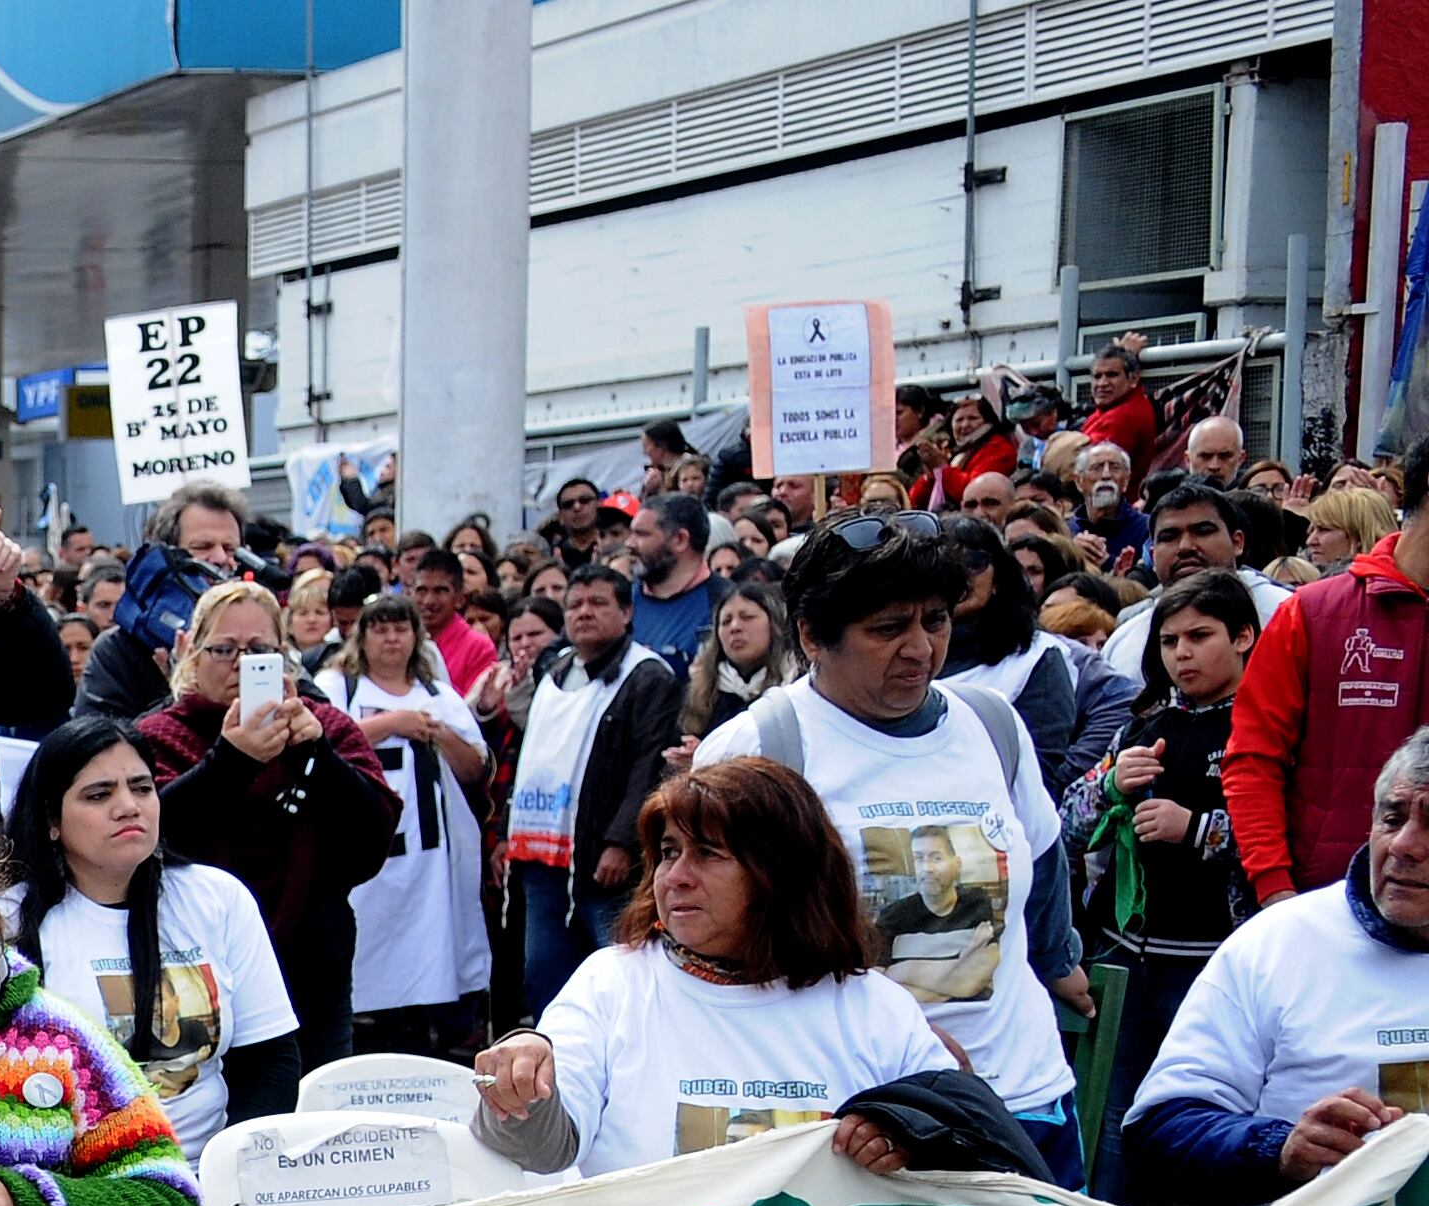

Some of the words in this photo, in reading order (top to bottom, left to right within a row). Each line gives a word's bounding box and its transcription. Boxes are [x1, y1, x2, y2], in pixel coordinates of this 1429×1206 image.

[146, 353, 202, 391] 22
[777, 357, 787, 366] LA
[153, 402, 180, 418] 25
[187, 395, 220, 415] DE
[783, 412, 811, 424] TODOS
[815, 410, 841, 421] SOMOS
[844, 408, 856, 419] LA
[160, 417, 228, 442] MAYO
[779, 431, 819, 444] ESCUELA
[132, 449, 235, 478] MORENO
[350, 1095, 365, 1105] ES
[367, 1094, 384, 1105] UN
[386, 1093, 433, 1104] CRIMEN
[679, 1079, 738, 1096] RUBEN
[742, 1080, 828, 1100] PRESENTE
[254, 1137, 275, 1151] NO
[332, 1127, 420, 1146] ACCIDENTE
[303, 1152, 325, 1168] UN
[330, 1147, 395, 1166] CRIMEN
[255, 1191, 275, 1203] QUE
[277, 1188, 341, 1202] APAREZCAN
[342, 1186, 364, 1197] LOS
[367, 1180, 431, 1195] CULPABLES
